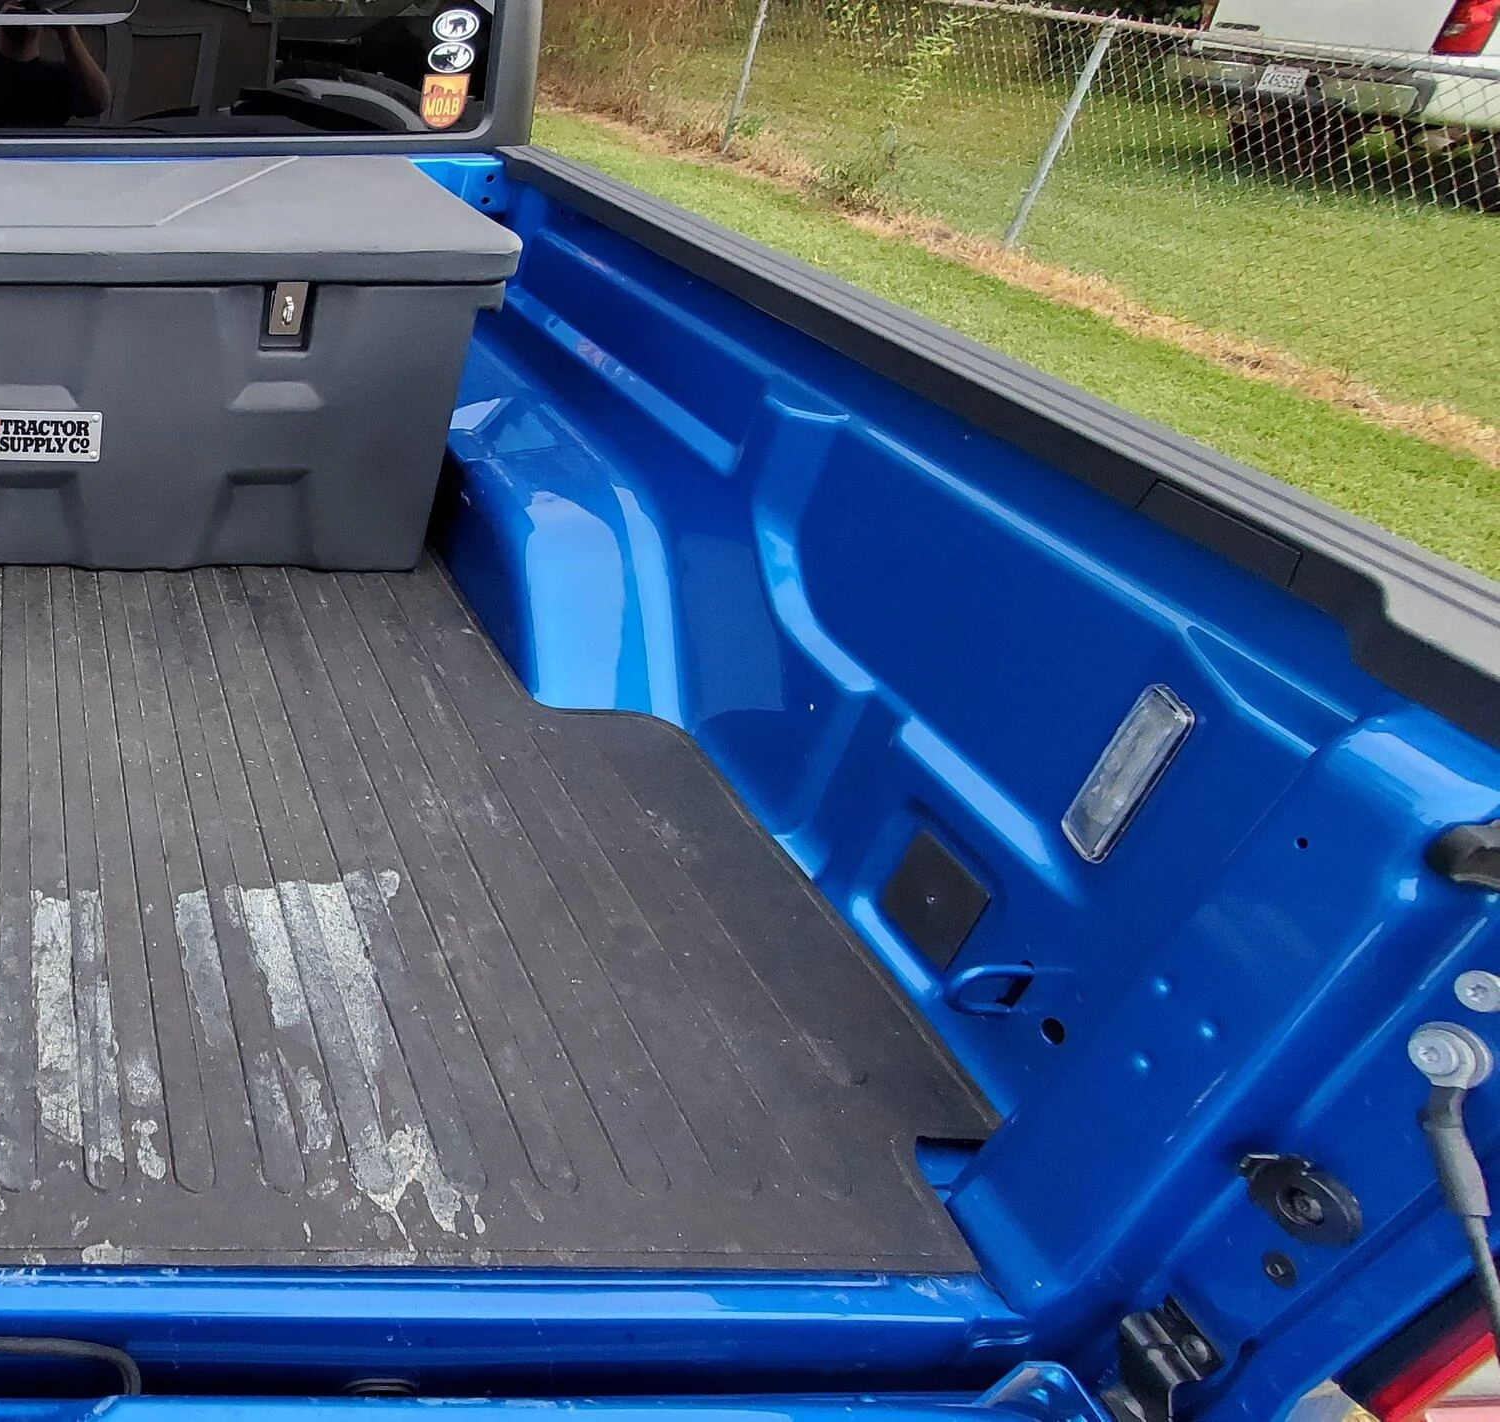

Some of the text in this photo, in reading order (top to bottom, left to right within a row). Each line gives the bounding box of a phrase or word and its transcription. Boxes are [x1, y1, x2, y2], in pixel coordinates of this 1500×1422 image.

[425, 97, 460, 116] MOAB
[0, 419, 90, 436] TRACTOR
[0, 436, 65, 453] SUPPLY
